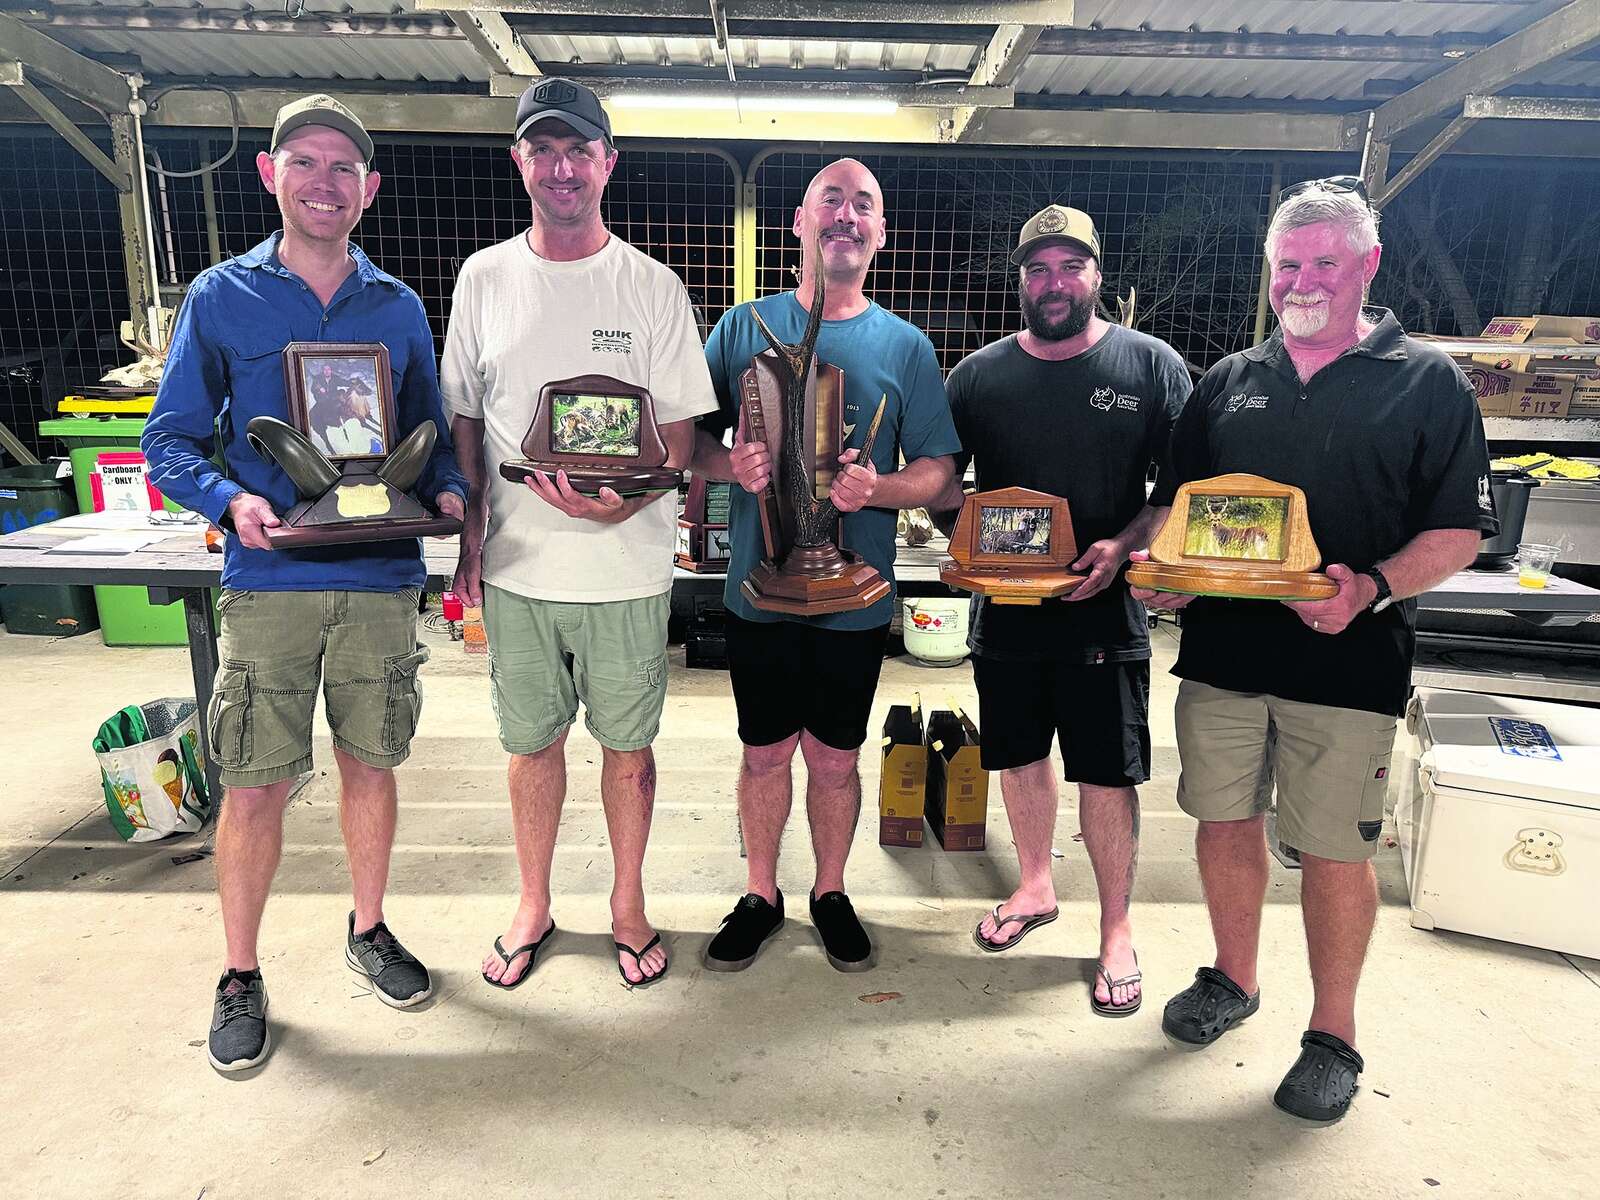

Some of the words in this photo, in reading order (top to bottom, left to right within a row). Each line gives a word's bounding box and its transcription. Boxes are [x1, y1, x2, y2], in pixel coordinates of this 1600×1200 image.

[592, 329, 632, 340] QUIK
[1117, 398, 1138, 407] Deer
[103, 466, 142, 474] Cardboard
[115, 476, 132, 485] ONLY
